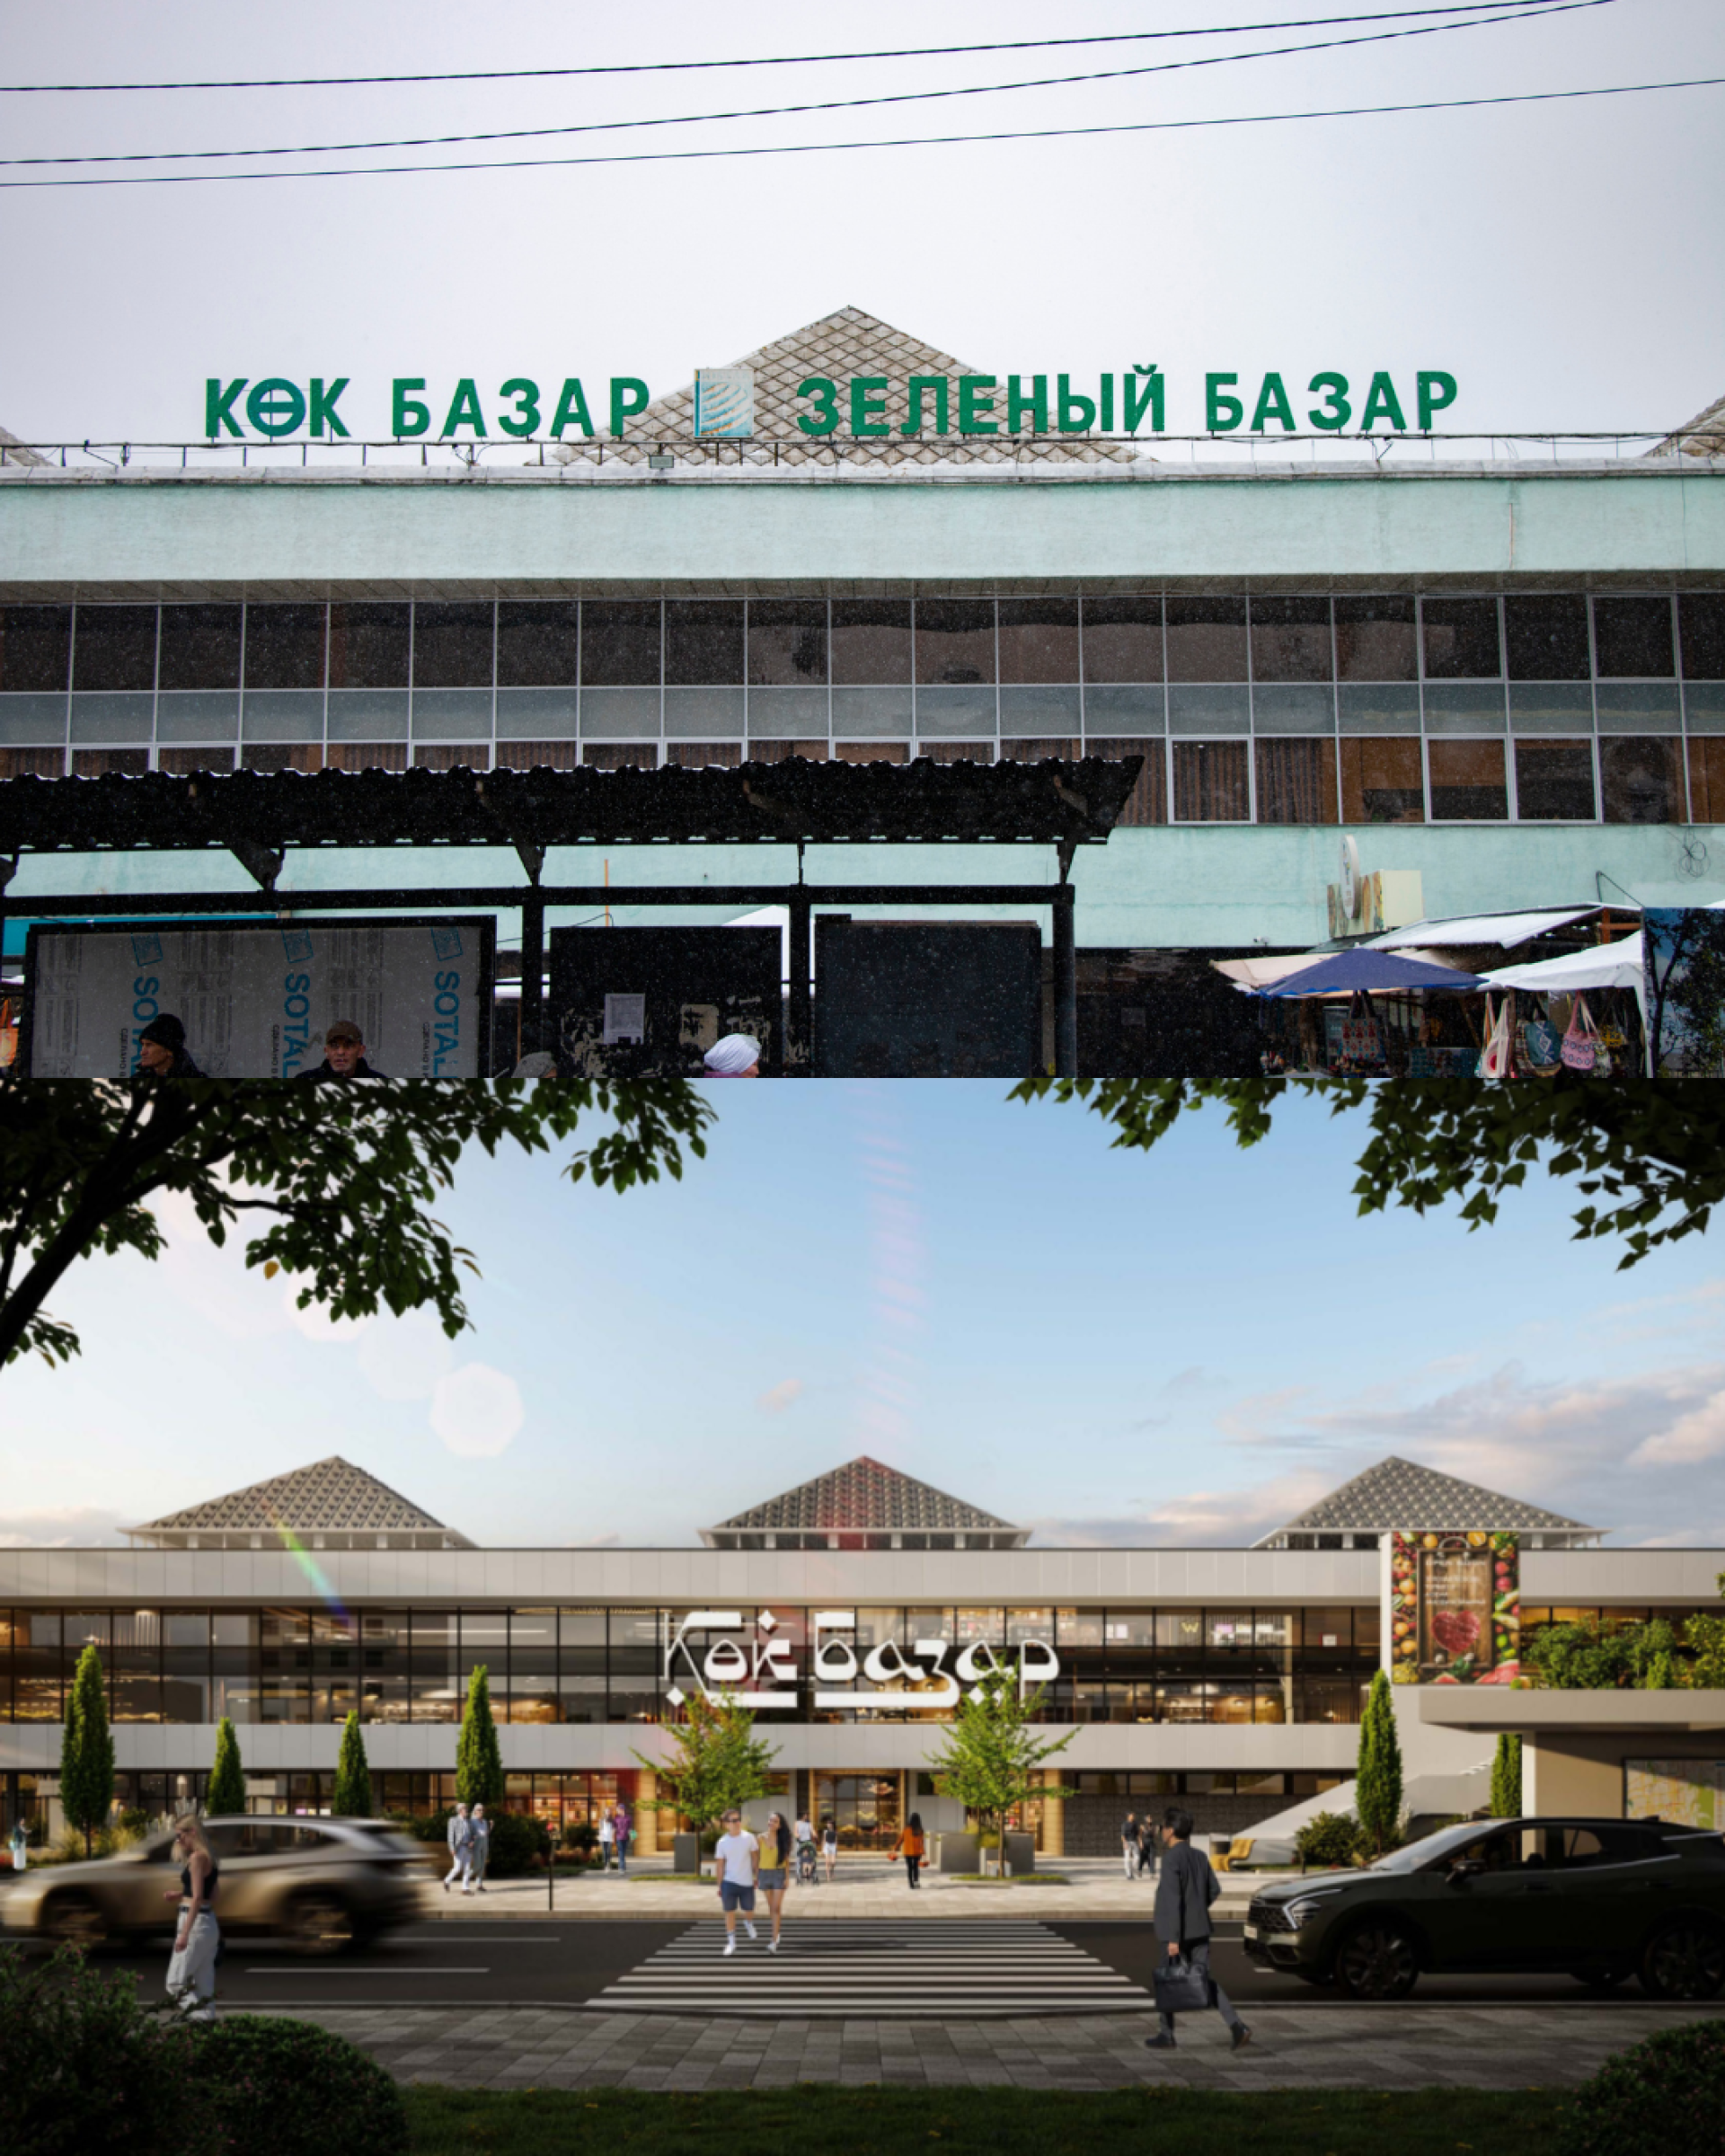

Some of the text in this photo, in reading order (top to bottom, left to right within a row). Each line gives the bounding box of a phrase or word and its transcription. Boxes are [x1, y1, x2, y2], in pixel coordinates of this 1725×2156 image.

[206, 378, 649, 437] КӨК БАЗАР
[797, 365, 1456, 435] ЗЕЛЕНЫЙ БАЗАР
[433, 971, 460, 1078] SOTAL
